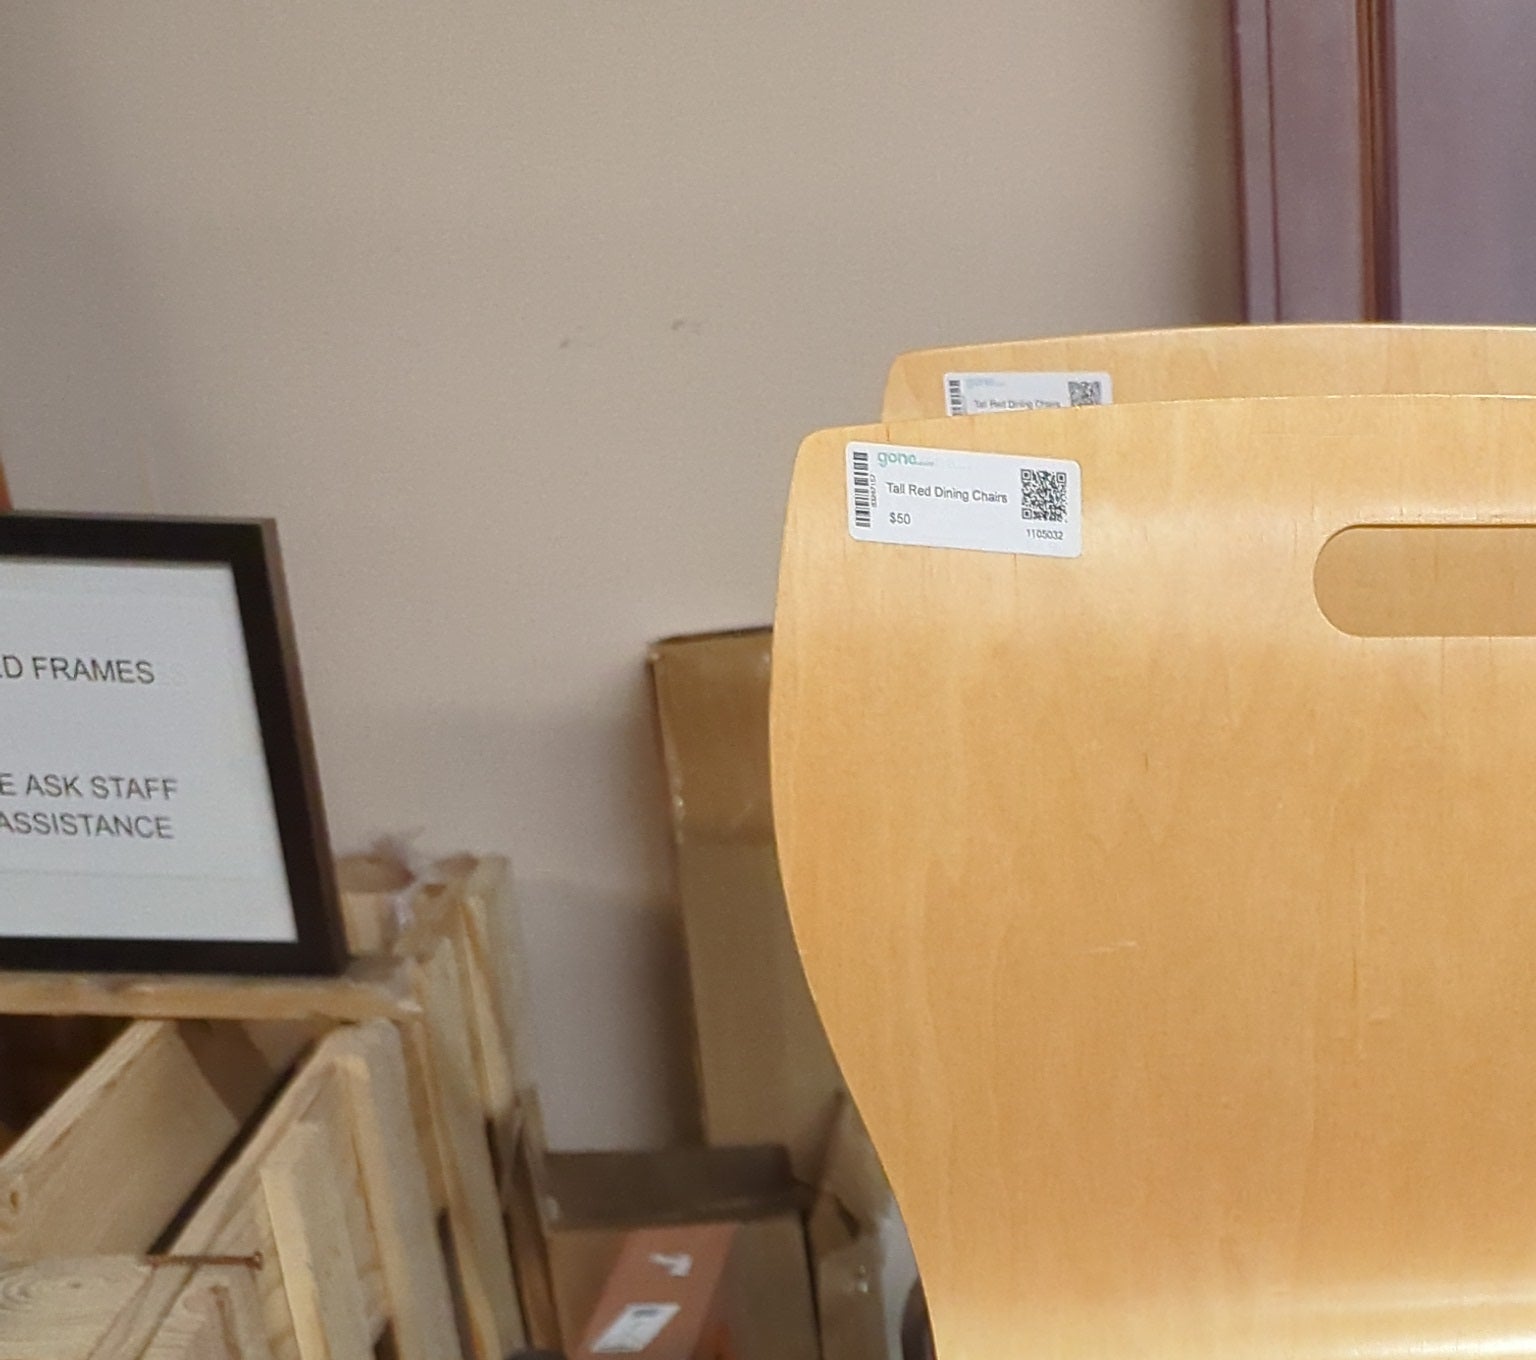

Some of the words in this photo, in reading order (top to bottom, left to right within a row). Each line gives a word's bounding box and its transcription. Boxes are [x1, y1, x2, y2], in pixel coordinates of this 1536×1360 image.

[886, 481, 906, 495] Tall
[908, 483, 932, 498] Red
[934, 486, 970, 503] Dining
[972, 489, 1008, 504] Chairs
[889, 511, 912, 526] $50
[32, 656, 156, 685] FRAMES
[26, 773, 84, 798] ASK
[90, 775, 178, 801] STAFF
